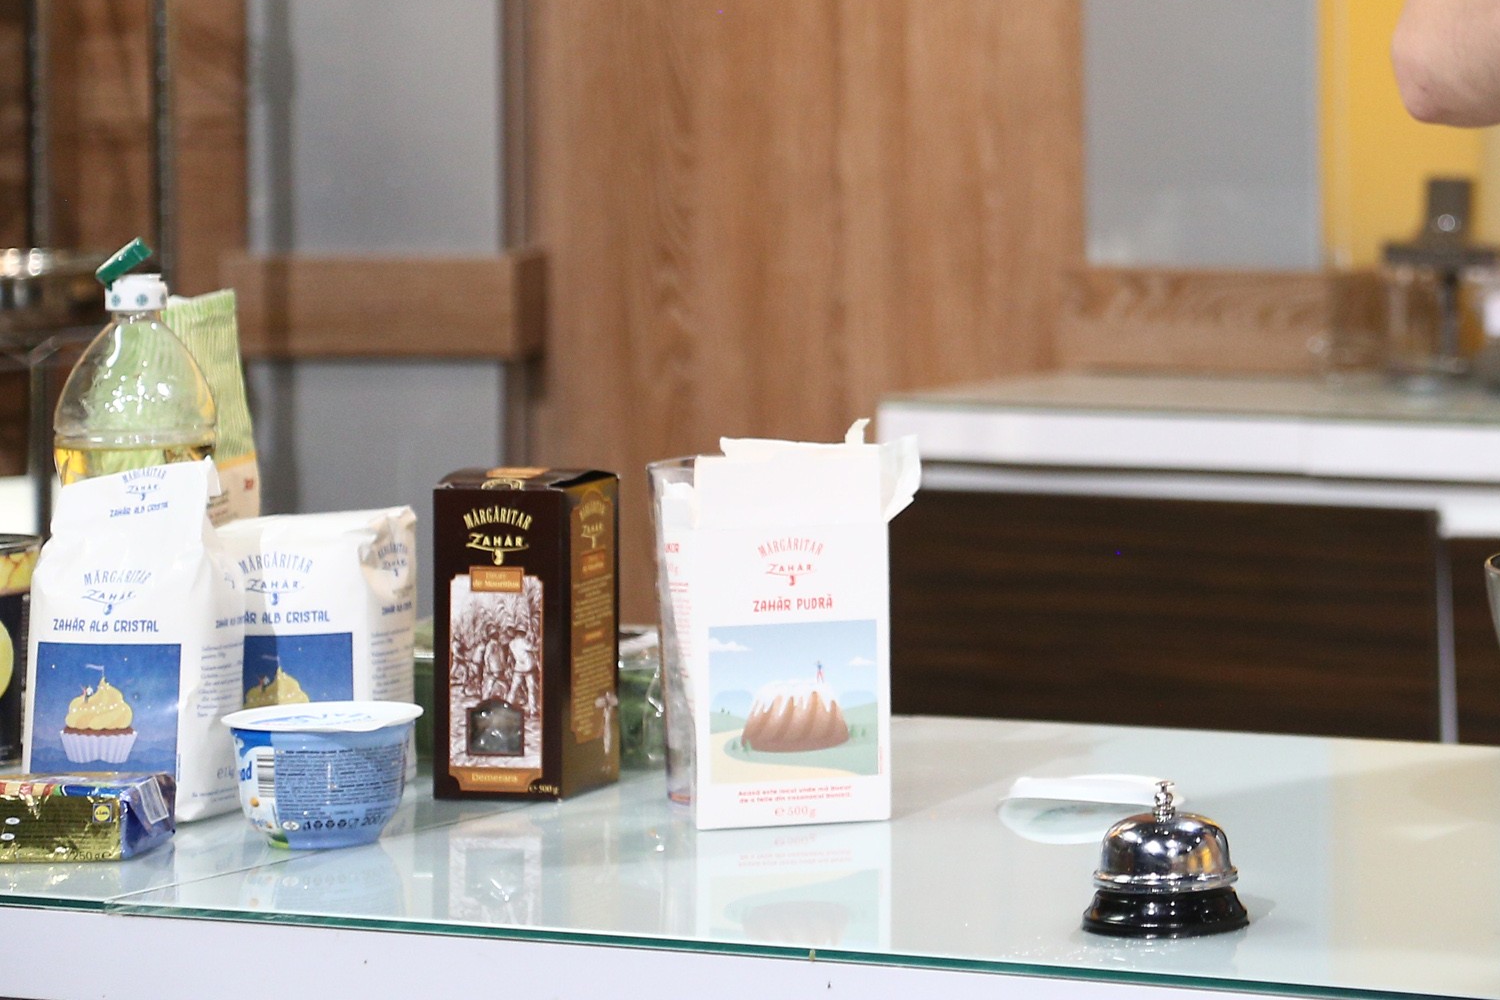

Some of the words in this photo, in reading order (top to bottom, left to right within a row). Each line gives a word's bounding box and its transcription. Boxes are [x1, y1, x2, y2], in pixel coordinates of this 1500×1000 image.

[753, 597, 791, 613] ZAHĂR
[797, 594, 833, 611] PUDRĂ
[262, 612, 281, 624] ALB
[286, 609, 331, 624] CRISTAL
[53, 617, 86, 632] ZAHĂR
[89, 620, 109, 632] ALB
[113, 619, 160, 633] CRISTAL
[471, 773, 519, 783] Demerara
[787, 805, 808, 817] 500
[72, 851, 93, 861] 250
